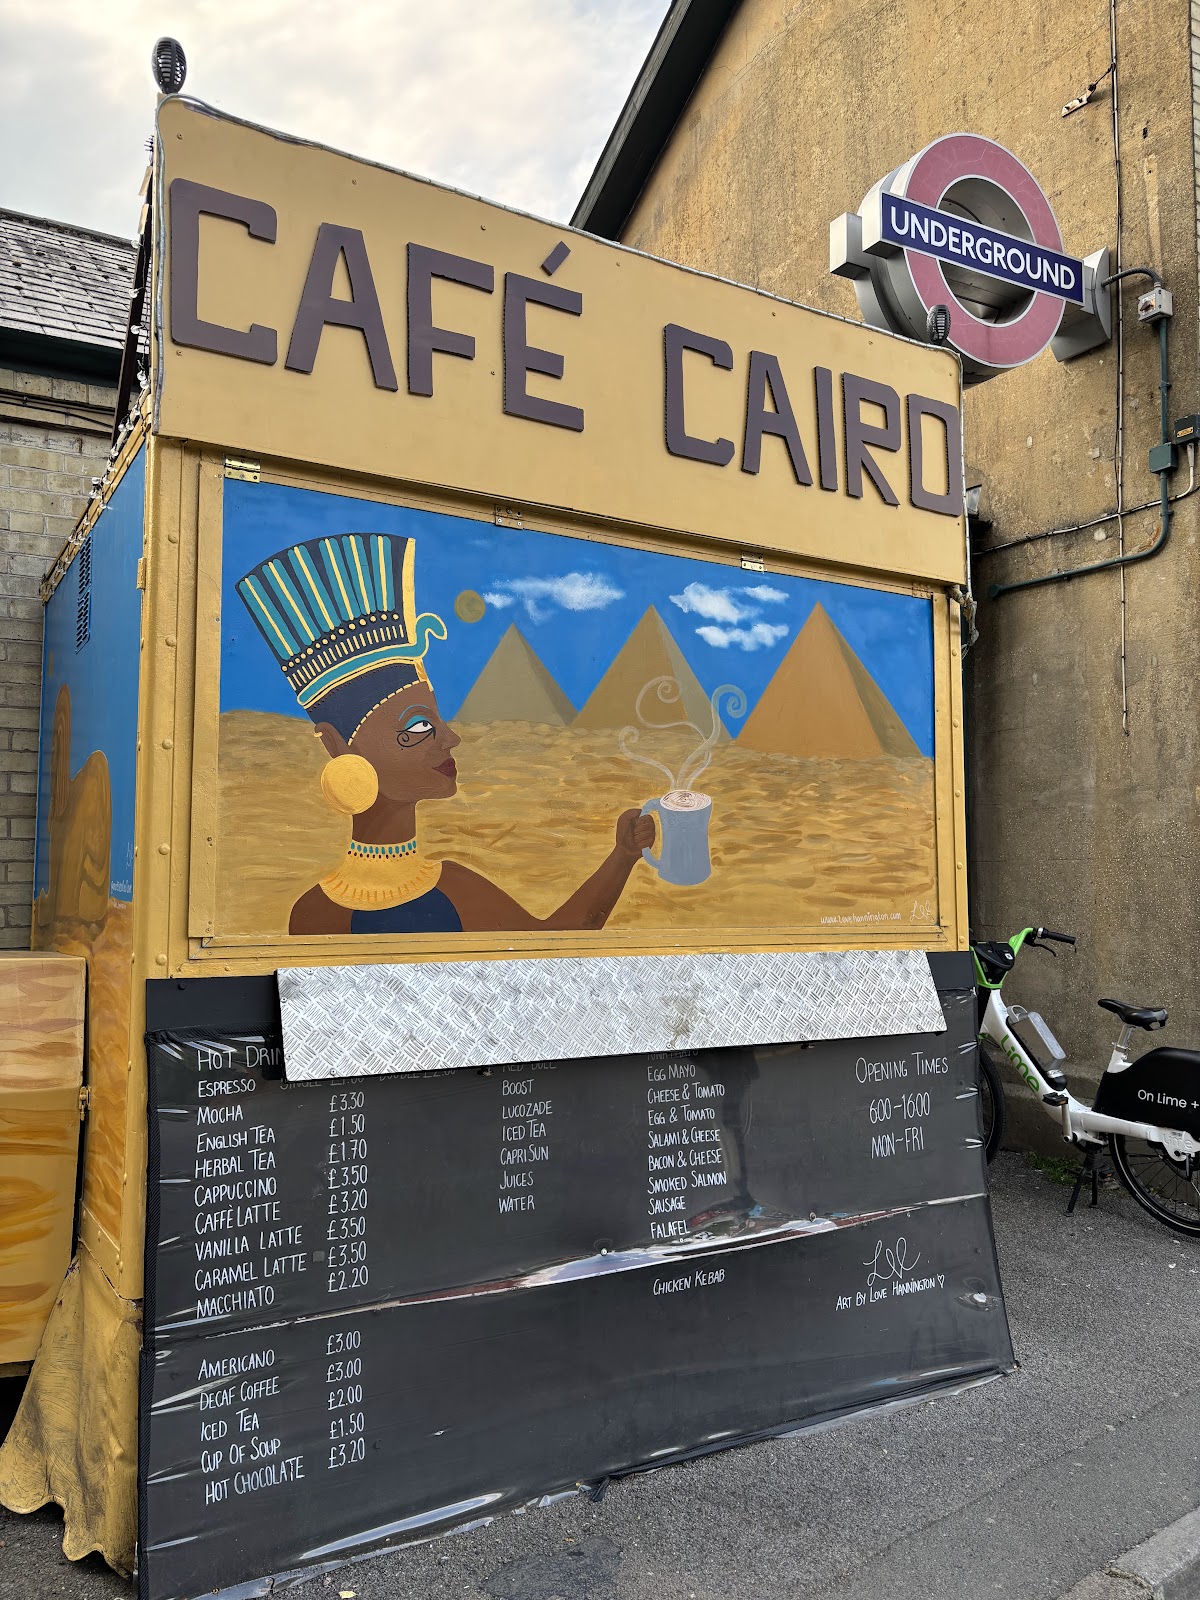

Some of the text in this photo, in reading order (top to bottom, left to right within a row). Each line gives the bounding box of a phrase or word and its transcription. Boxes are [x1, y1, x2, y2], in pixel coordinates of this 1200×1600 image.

[890, 206, 1076, 290] UNDERGROUND
[170, 178, 962, 516] CAFÉ CAIRO
[197, 1047, 236, 1072] HOT
[856, 1051, 949, 1083] OPENING TIMES
[1001, 1034, 1040, 1093] Lime
[647, 1063, 696, 1082] EGG MAYO
[198, 1079, 256, 1098] ESPRESSO
[502, 1078, 534, 1096] BOOST
[647, 1082, 725, 1104] CHEESE & TOMATO
[1137, 1089, 1154, 1102] On
[1157, 1092, 1187, 1108] Lime
[329, 1091, 365, 1113] £3.30
[502, 1100, 553, 1119] LUCOZADE
[197, 1104, 243, 1126] MOCHA
[329, 1113, 365, 1137] £1.50
[648, 1104, 715, 1126] EGG & TOMATO
[196, 1125, 276, 1154] ENGLISH TEA
[502, 1118, 547, 1142] ICED TEA
[648, 1126, 721, 1149] SALAMI & CHEESE
[195, 1148, 276, 1179] HERBAL TEA
[328, 1138, 367, 1164] £1.70
[648, 1148, 722, 1171] BACON & CHEESE
[327, 1164, 368, 1189] £3.50
[499, 1171, 534, 1190] JUICES
[647, 1170, 727, 1194] SMOKED SALMON
[194, 1176, 277, 1208] CAPPUCCINO
[328, 1189, 368, 1214] £3.20
[499, 1195, 535, 1213] WATER
[237, 1201, 281, 1227] LATTE
[648, 1195, 686, 1215] SAUSAGE
[326, 1216, 366, 1240] £3.50
[650, 1219, 690, 1239] FALAFEL
[195, 1225, 303, 1262] VANILLA LATTE
[328, 1240, 367, 1268] £3.50
[194, 1252, 308, 1292] CARAMEL LATTE
[328, 1265, 369, 1292] £2.20
[653, 1268, 725, 1296] CHICKEN KEBAB
[196, 1285, 275, 1314] MACCHIATO
[835, 1295, 852, 1311] ART
[856, 1291, 866, 1307] BY
[870, 1286, 887, 1303] LOVE
[325, 1330, 361, 1355] £3.00
[197, 1349, 275, 1380] AMERICANO
[326, 1357, 362, 1383] £3.00
[200, 1376, 280, 1411] DECAF COFFEE
[328, 1384, 363, 1411] £2.00
[200, 1408, 260, 1441] ICED TEA
[329, 1411, 365, 1440] £1.50
[201, 1436, 281, 1474] CUP OF SOUP
[327, 1437, 365, 1470] £3.20
[205, 1455, 305, 1506] HOT CHOCOLATE
